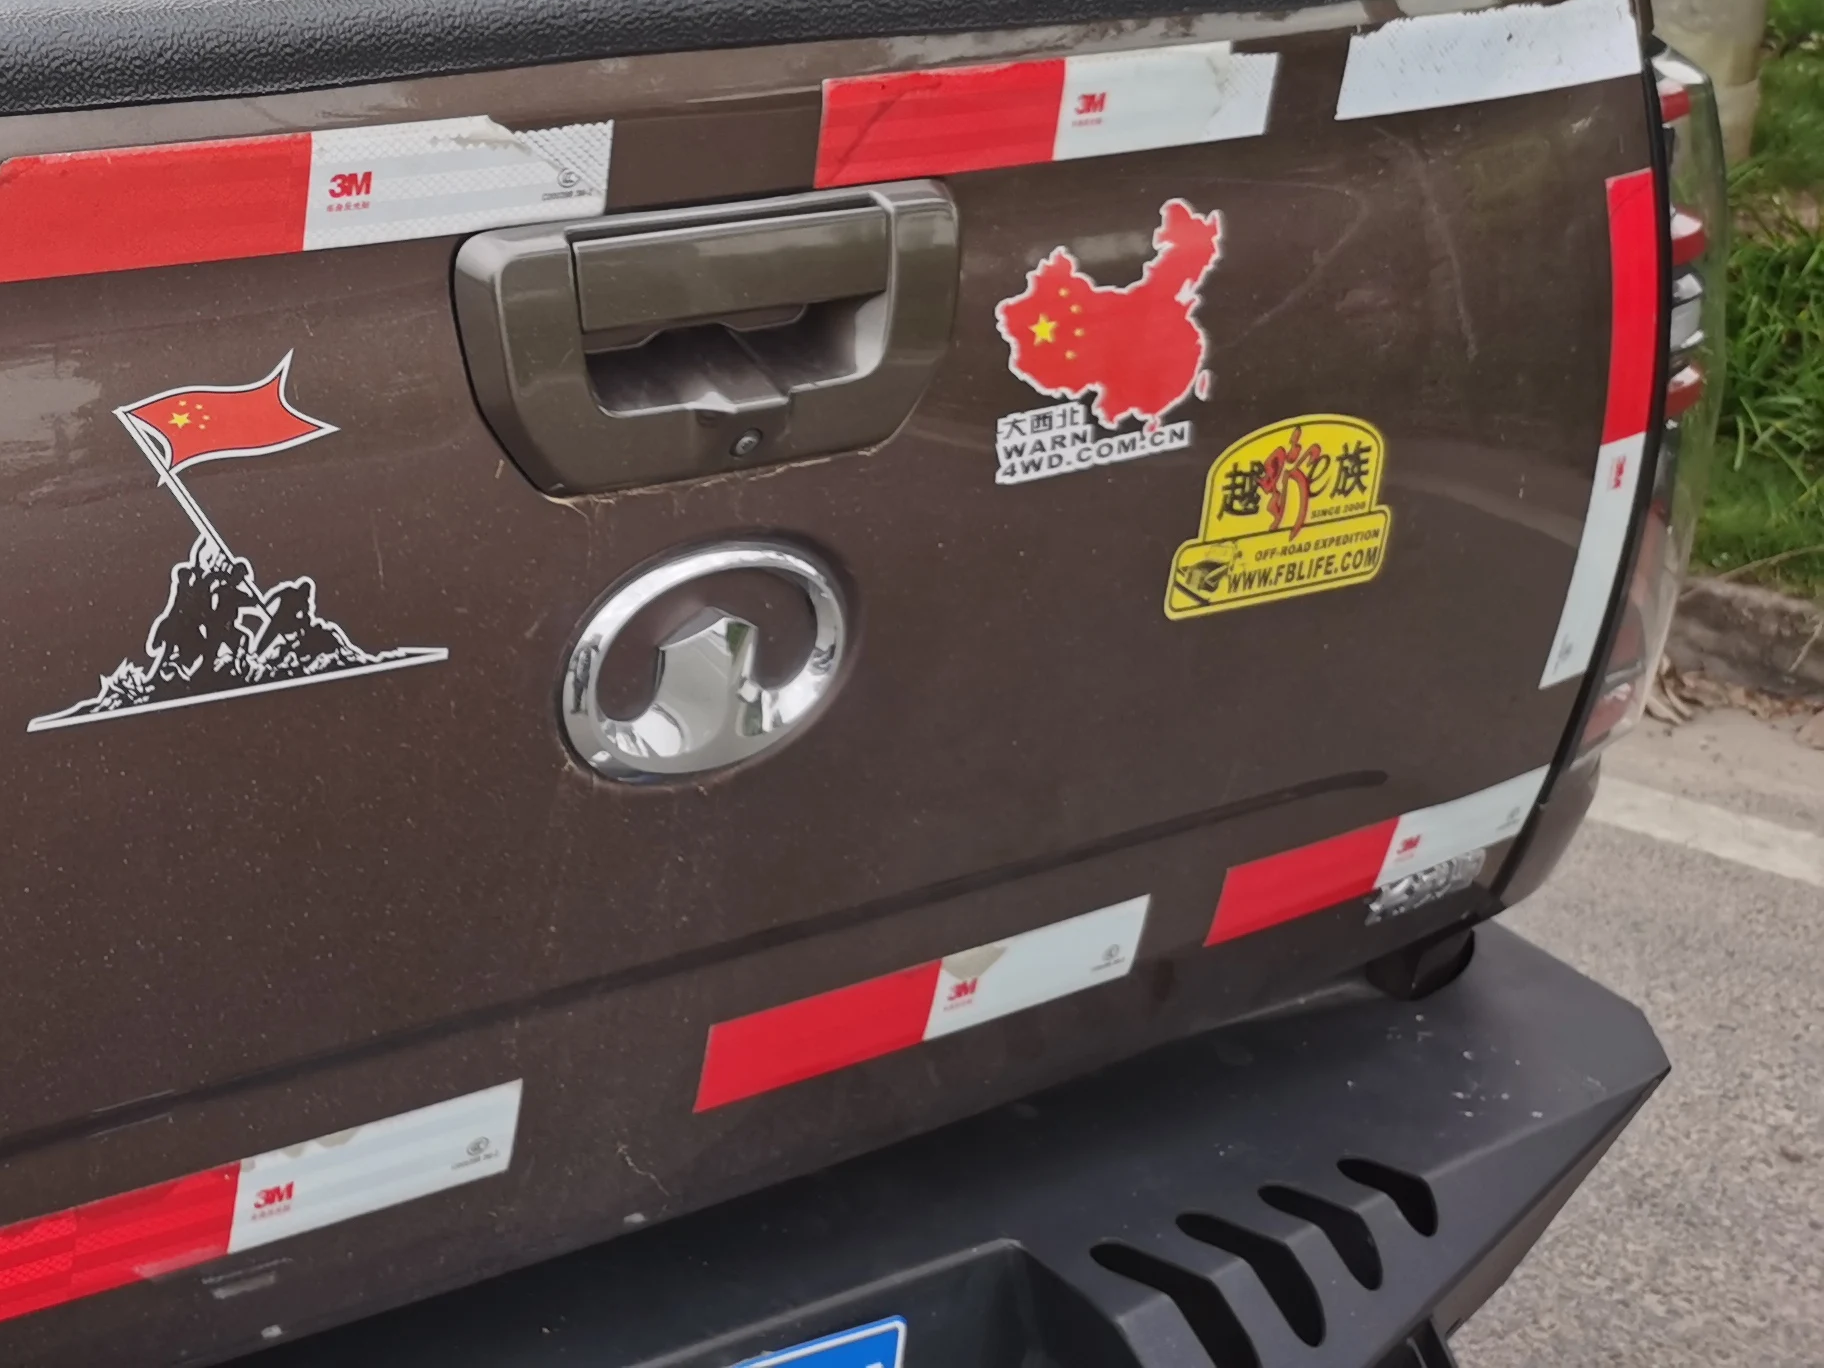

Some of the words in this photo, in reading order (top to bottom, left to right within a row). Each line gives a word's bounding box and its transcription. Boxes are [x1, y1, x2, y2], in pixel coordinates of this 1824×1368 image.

[1074, 92, 1106, 114] 3M
[328, 171, 372, 198] 3M
[1002, 407, 1080, 440] 大西北
[1002, 427, 1186, 477] 4WD.COM.CN
[1003, 430, 1087, 459] WARN
[1255, 542, 1312, 561] OFF-ROAD
[1313, 528, 1380, 551] EXPEDITION
[1227, 547, 1378, 594] WWW.FBLIFE.COM
[947, 977, 978, 1000] 3M
[254, 1181, 294, 1209] 3M
